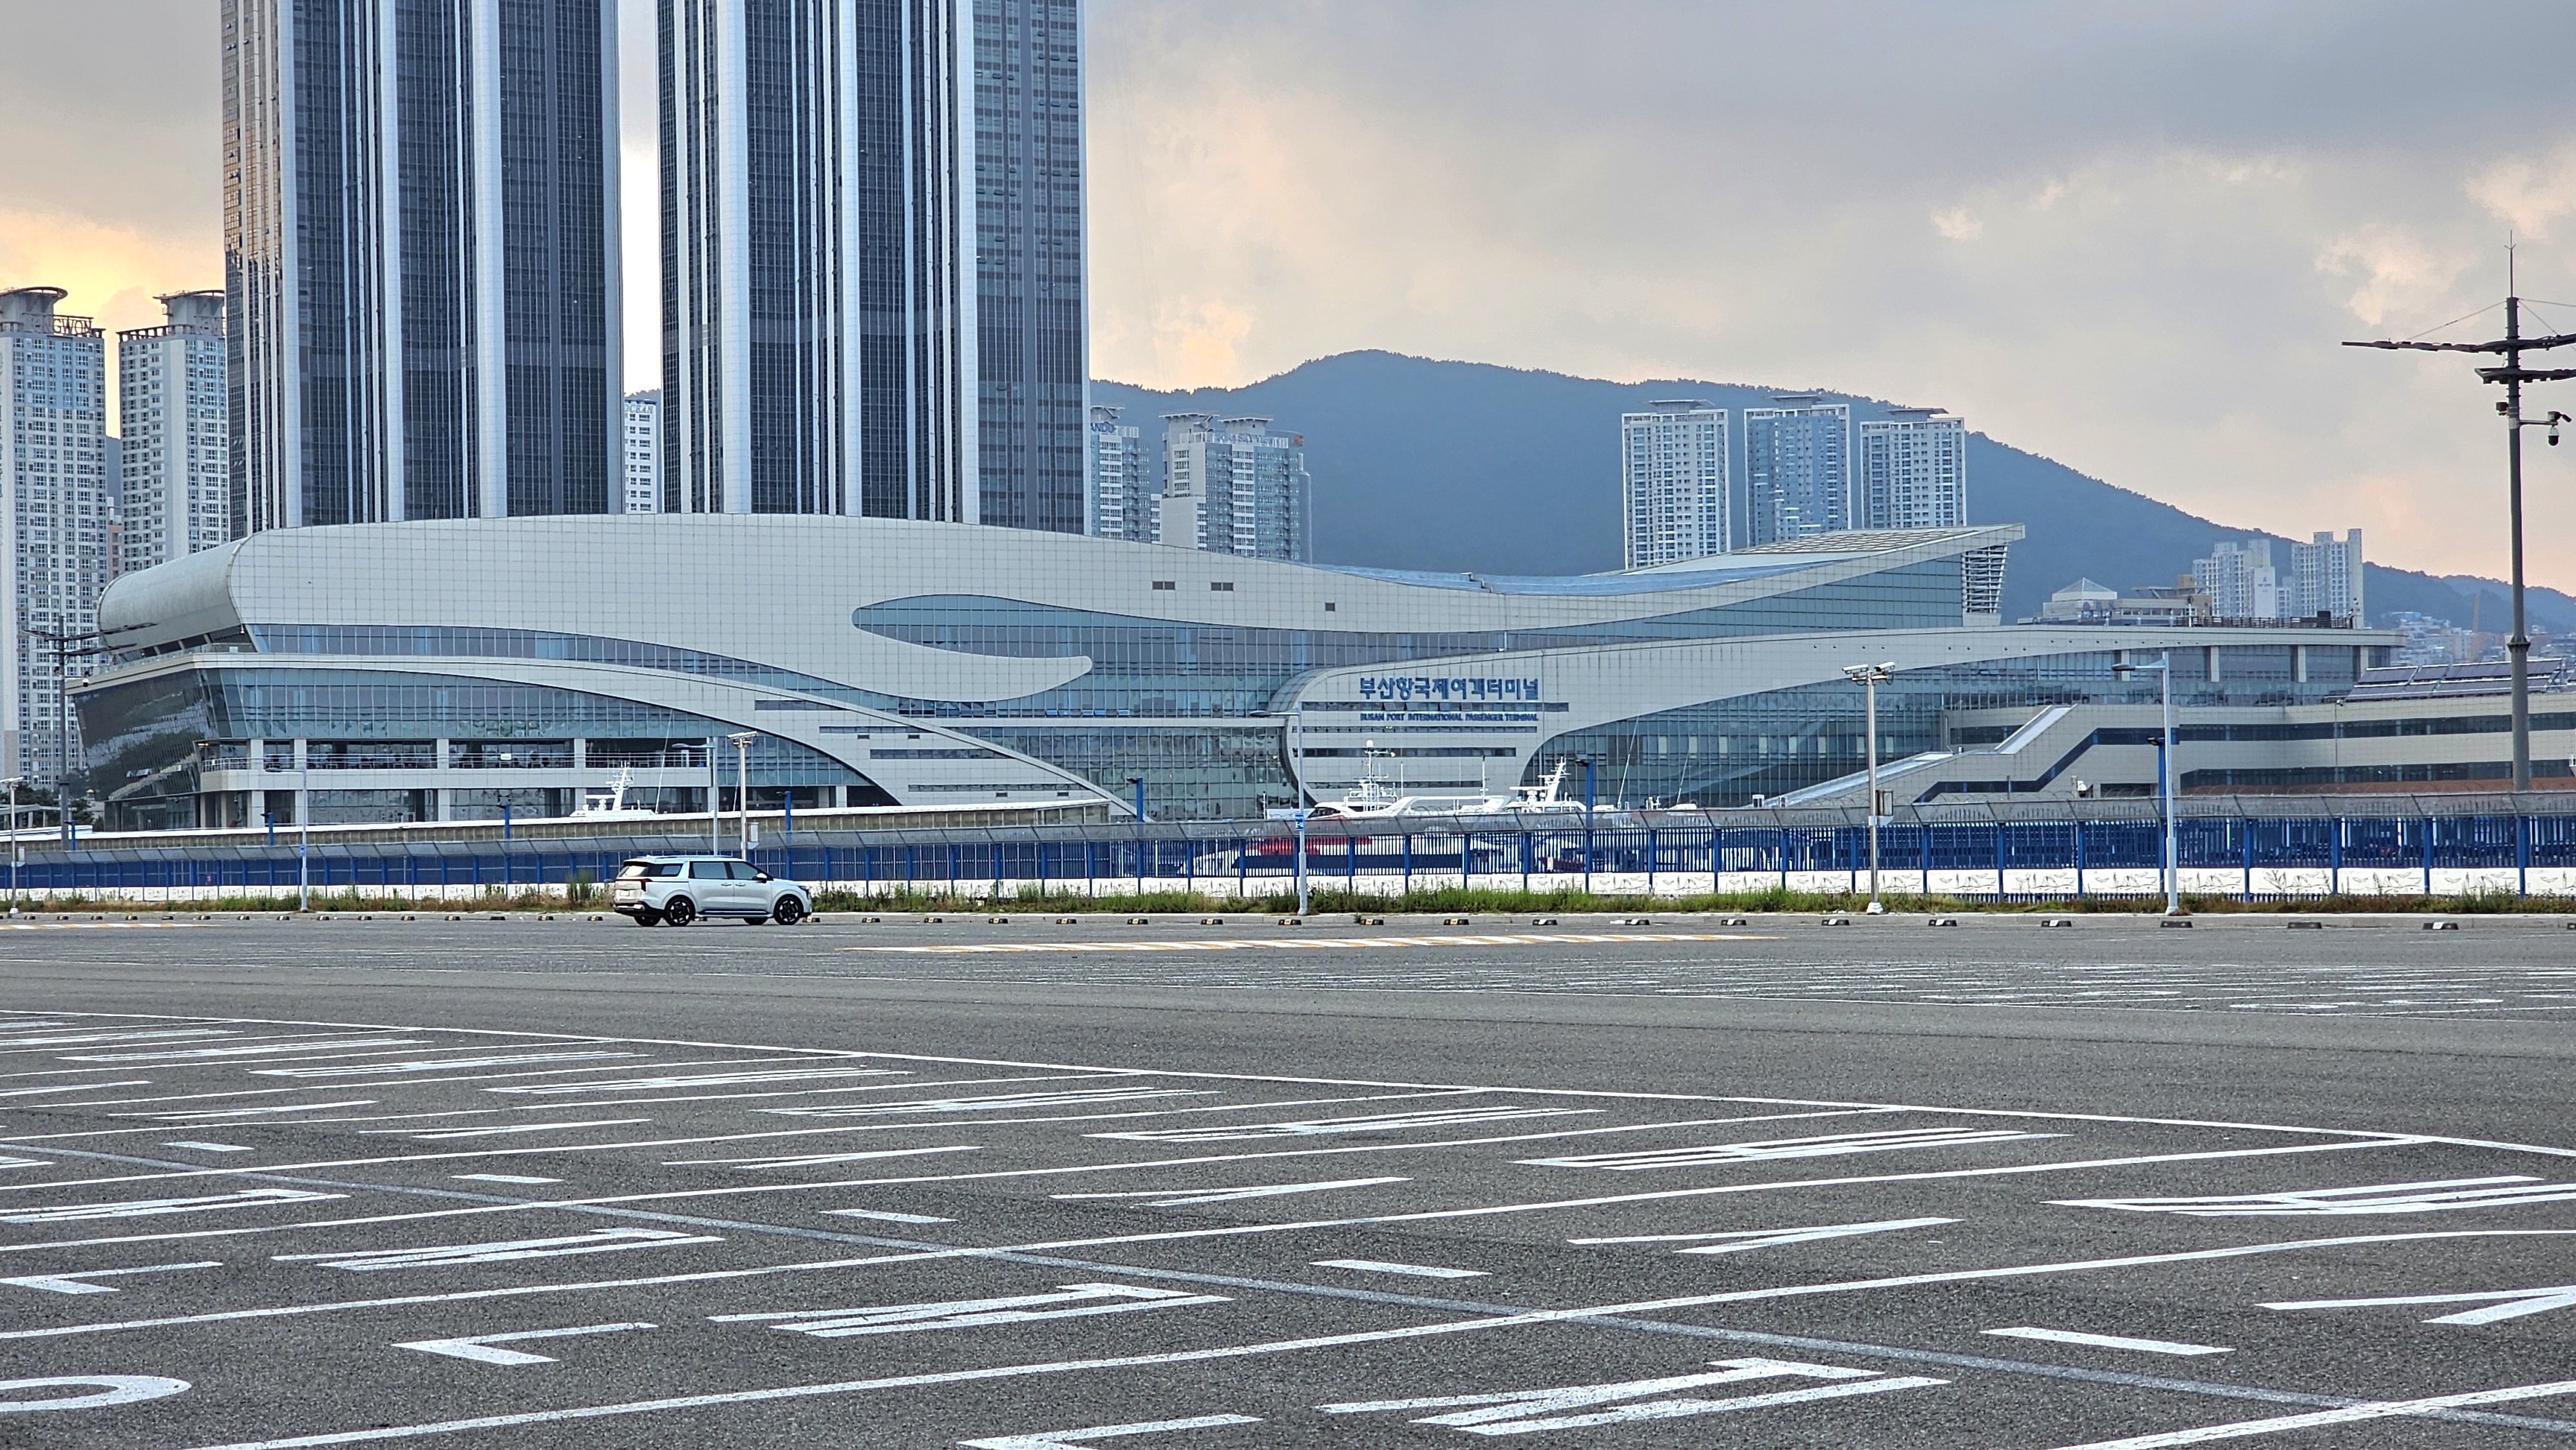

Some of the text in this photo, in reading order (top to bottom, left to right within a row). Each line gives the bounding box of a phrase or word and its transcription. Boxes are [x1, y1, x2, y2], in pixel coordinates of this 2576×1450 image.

[1359, 677, 1539, 701] 부산항국제여객터미널
[1360, 713, 1385, 721] BUSAN
[1387, 713, 1405, 721] PORT
[1408, 713, 1463, 721] INTERNATIONAL
